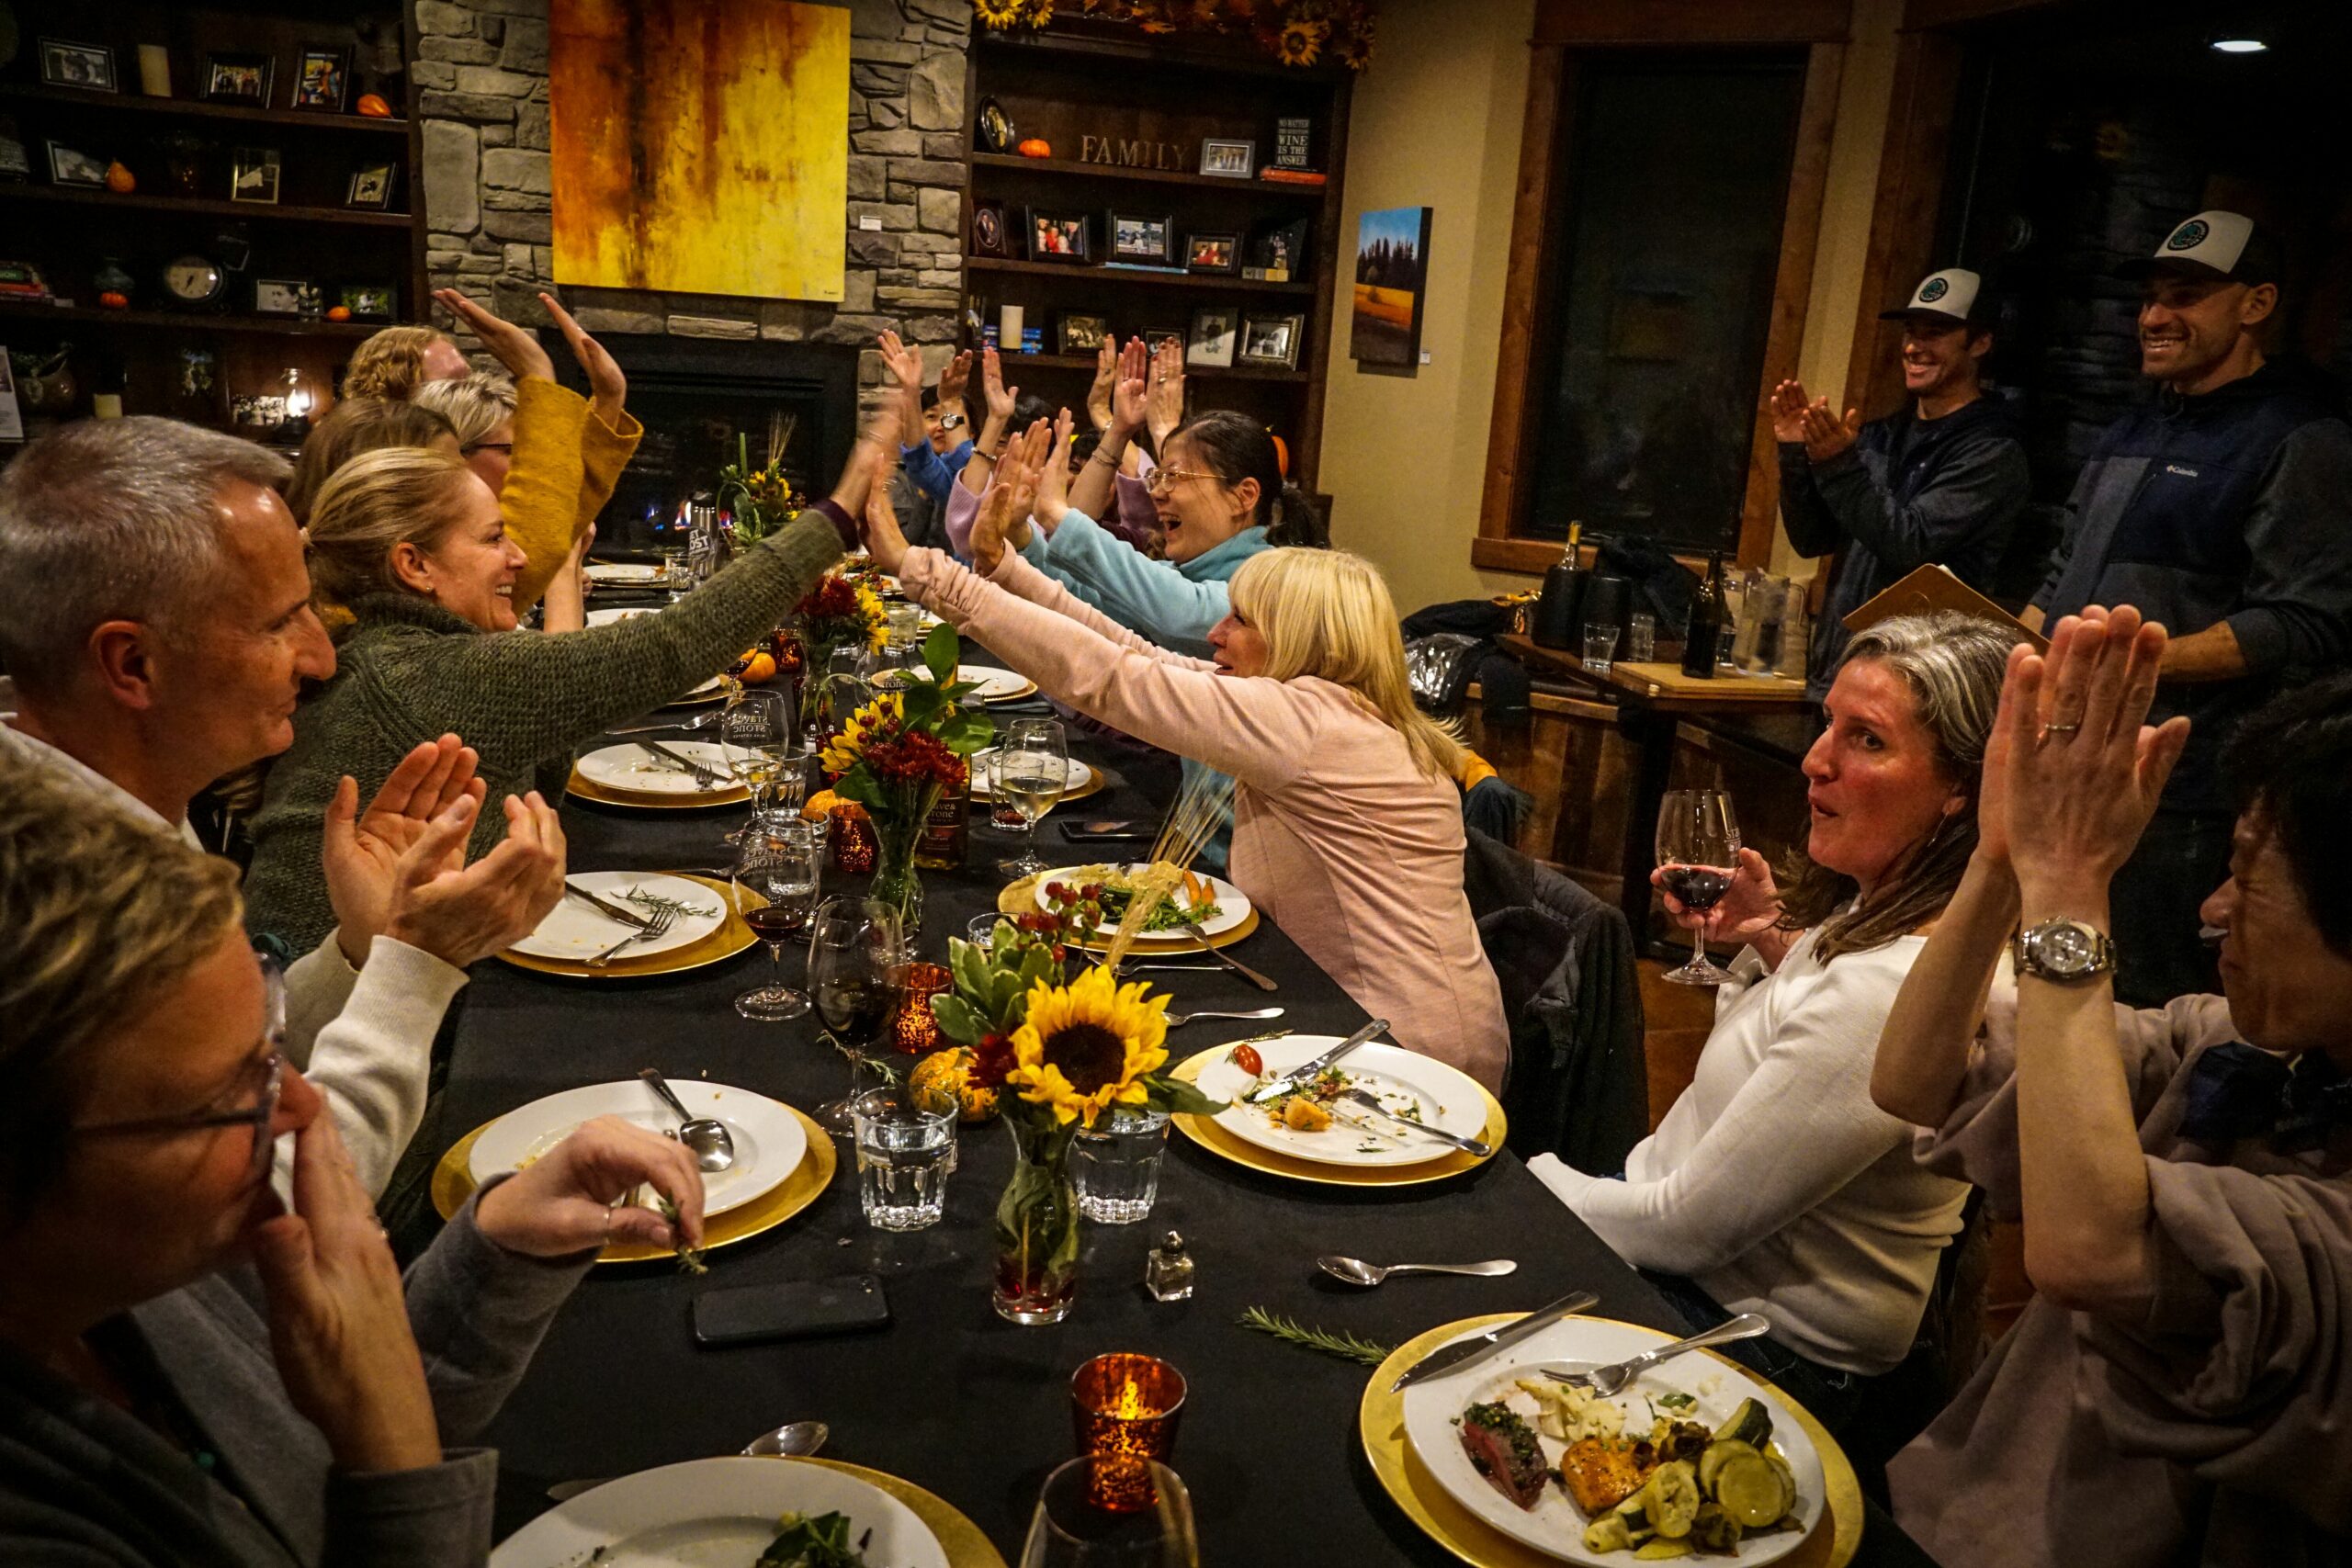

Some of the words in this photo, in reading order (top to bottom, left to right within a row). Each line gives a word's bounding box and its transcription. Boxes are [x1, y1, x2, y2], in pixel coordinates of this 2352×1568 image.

[1278, 135, 1308, 145] WINE
[1080, 135, 1189, 171] FAMILY
[1278, 145, 1287, 154] IS
[1290, 146, 1307, 155] THE
[1276, 154, 1306, 165] ANSWER
[689, 529, 699, 539] ET
[689, 536, 709, 550] OST
